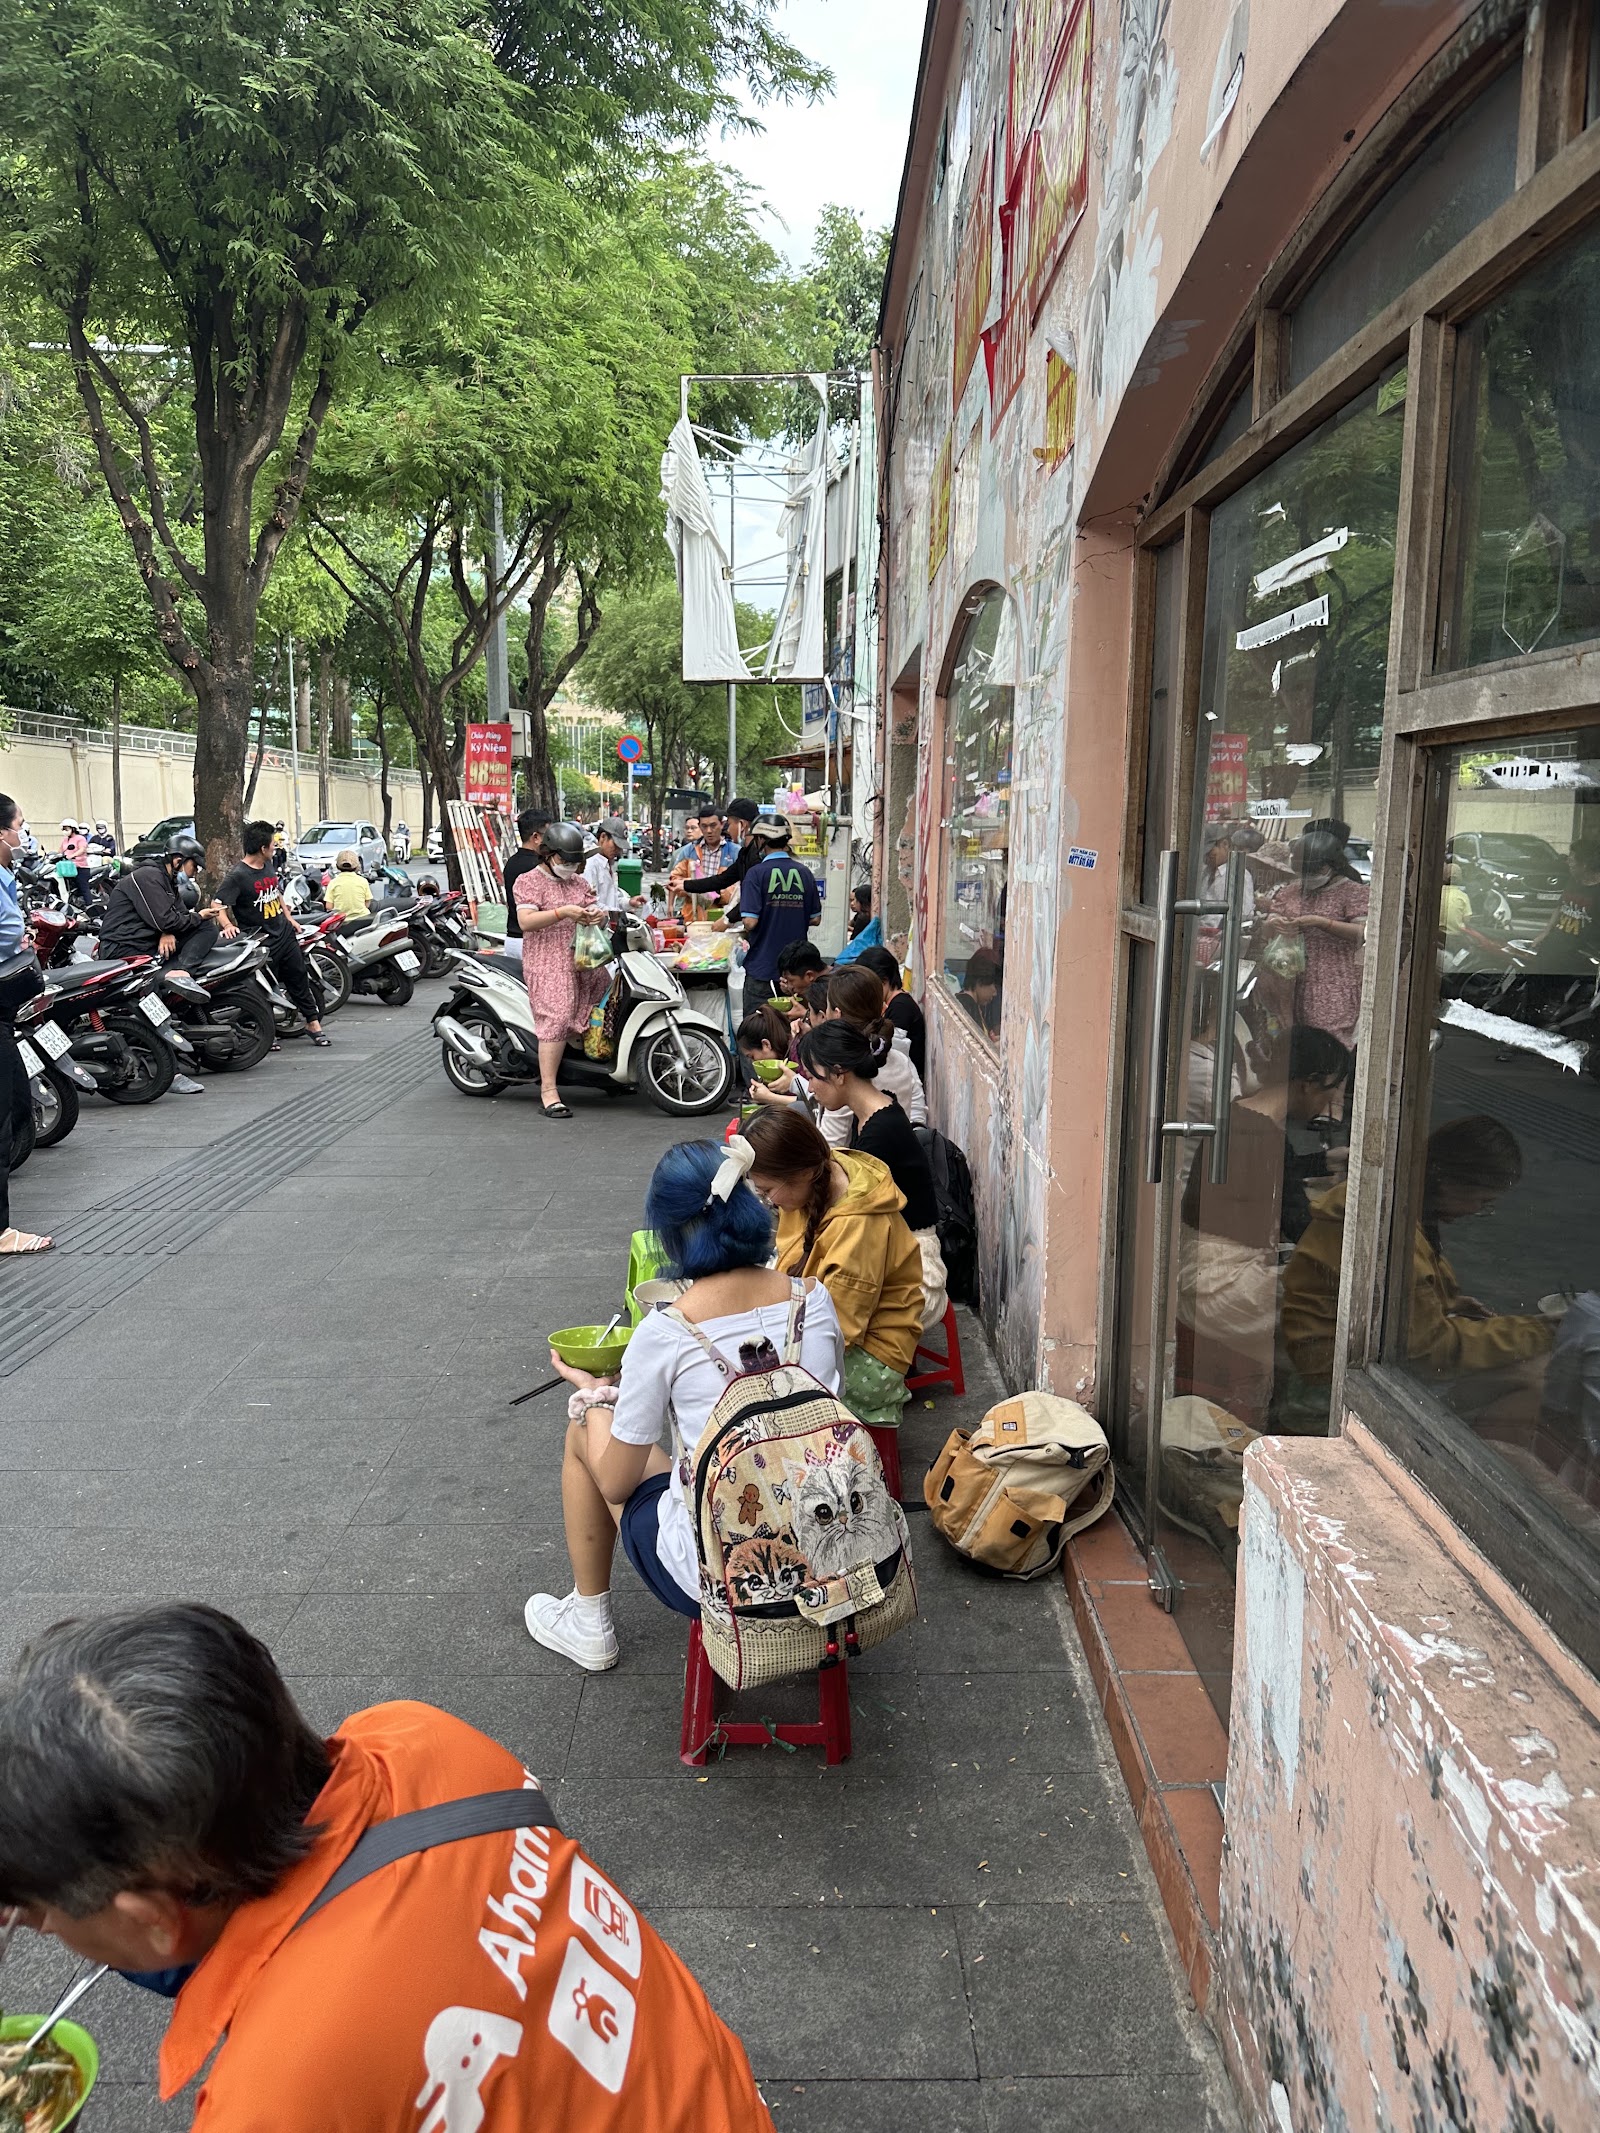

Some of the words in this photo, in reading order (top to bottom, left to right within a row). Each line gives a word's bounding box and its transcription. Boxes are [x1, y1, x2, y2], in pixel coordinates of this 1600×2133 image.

[483, 744, 507, 754] Niệm
[470, 761, 489, 785] 98
[479, 1768, 550, 2002] Aham
